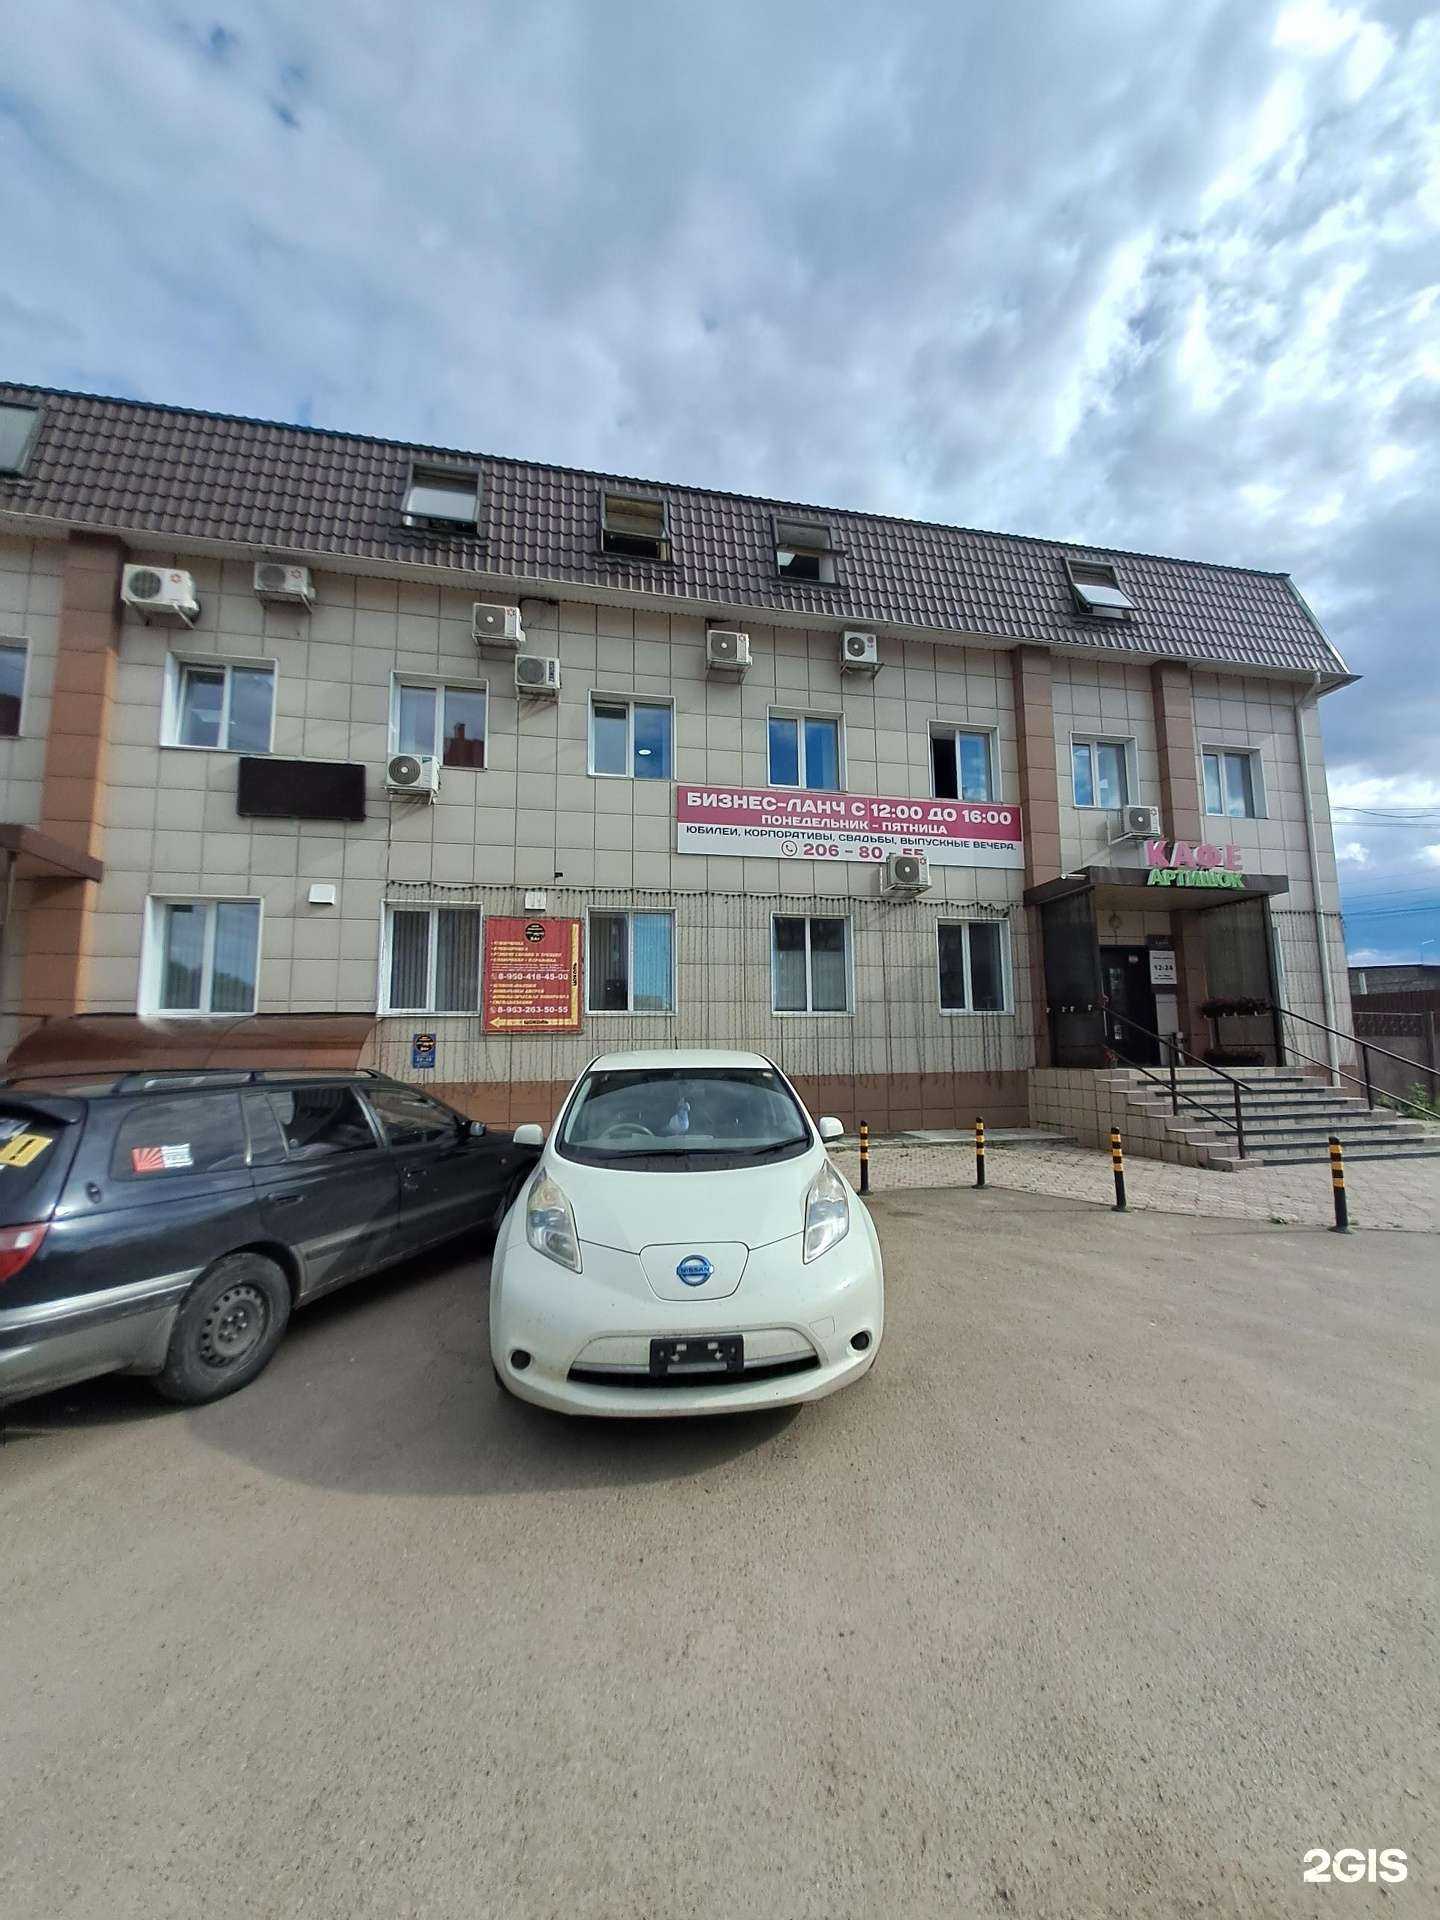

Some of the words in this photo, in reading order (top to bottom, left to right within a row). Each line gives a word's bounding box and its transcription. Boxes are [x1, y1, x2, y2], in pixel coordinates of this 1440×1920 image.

[687, 792, 845, 816] БИЗНЕС-ЛАНЧ
[851, 802, 866, 817] С
[871, 804, 923, 819] 12:00
[928, 807, 957, 821] ДО
[962, 809, 1012, 825] 16:00
[761, 814, 869, 830] ПОНЕДЕЛЬНИК
[882, 821, 948, 835] ПЯТНИЦА
[744, 828, 836, 842] КОРПОРАТИВЫ,
[838, 833, 897, 845] СВАДЬБЫ,
[900, 837, 970, 849] ВЫПУСКНЫЕ
[803, 843, 840, 857] 206
[858, 846, 884, 859] 80
[1144, 840, 1243, 870] КАФЕ
[1147, 868, 1246, 888] АРТИШОК
